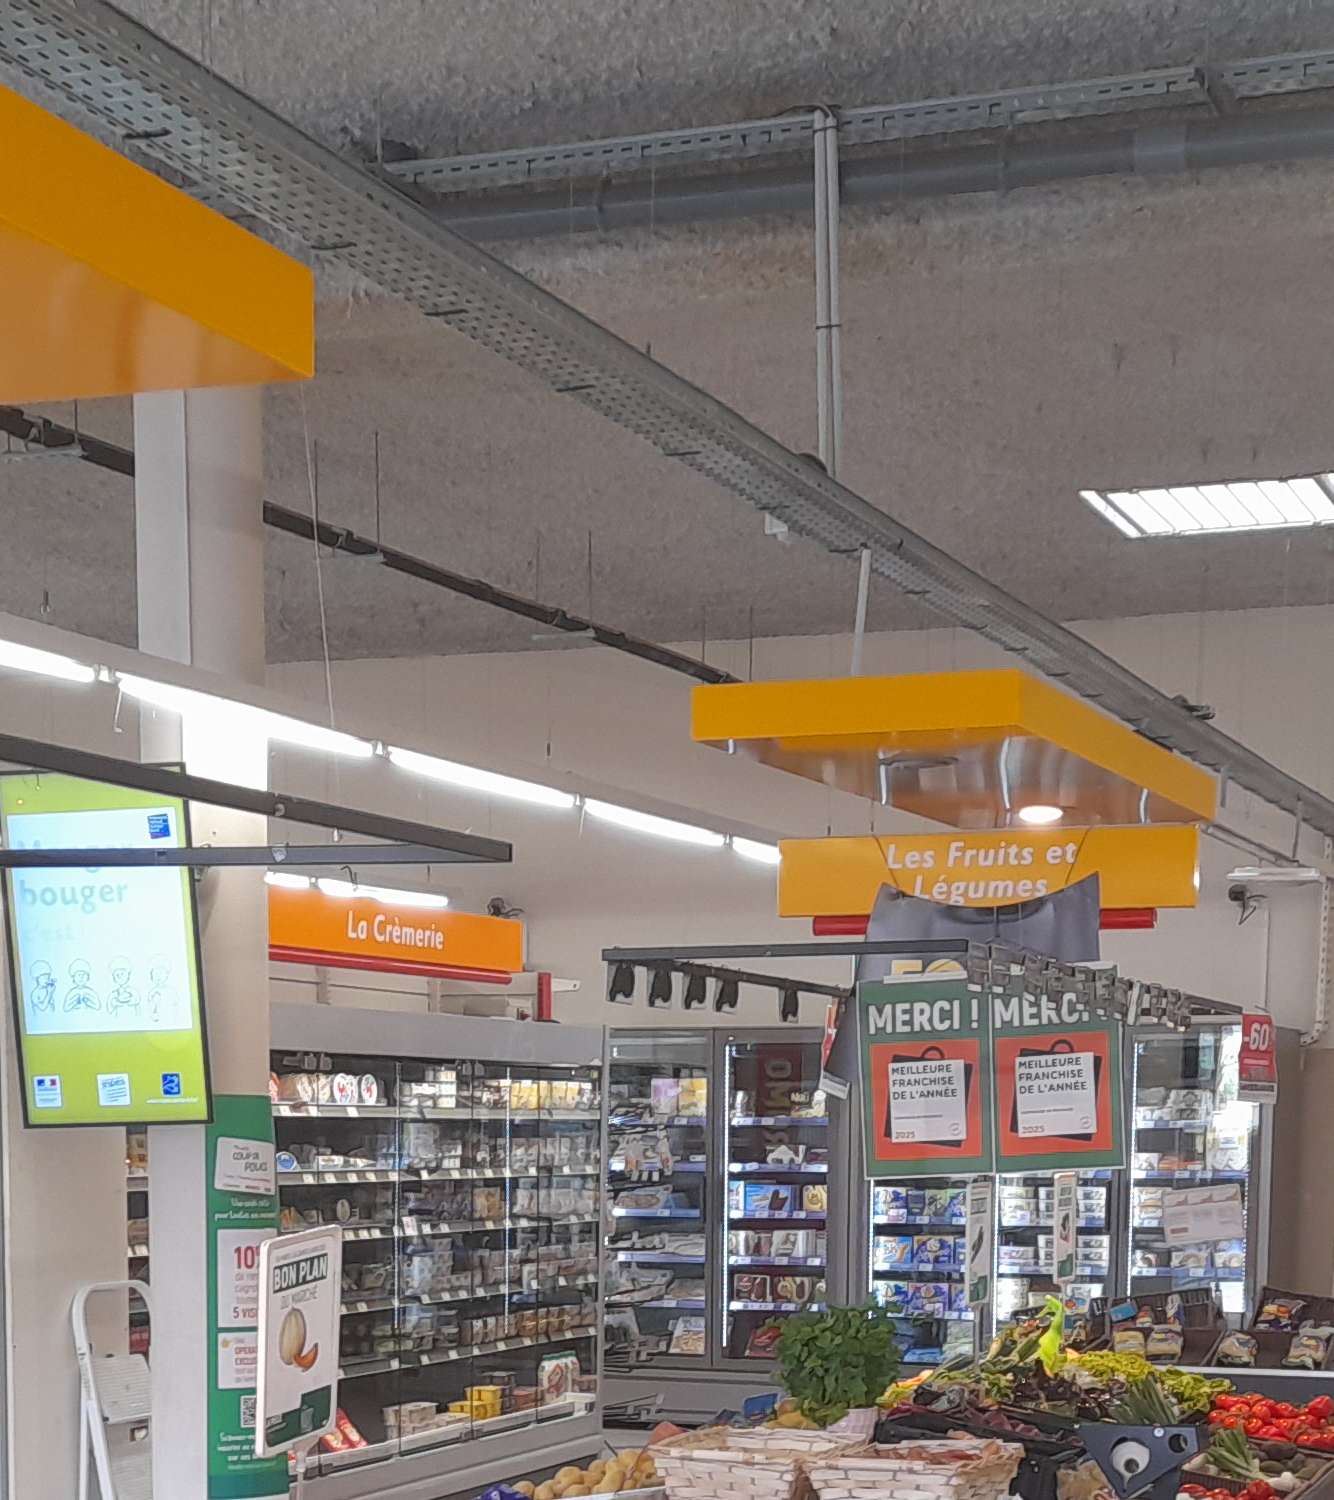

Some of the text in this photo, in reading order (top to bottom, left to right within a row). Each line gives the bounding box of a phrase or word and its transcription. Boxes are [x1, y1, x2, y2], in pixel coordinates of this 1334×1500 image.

[887, 840, 1078, 870] Les Fruits et
[19, 880, 128, 913] bouger
[913, 876, 1049, 905] Légumes
[346, 910, 445, 951] La Crèmerie
[868, 998, 979, 1035] MERCI !
[891, 1064, 953, 1076] MEILLEURE
[1018, 1057, 1082, 1070] MEILLEURE
[892, 1076, 955, 1088] FRANCHISE
[1018, 1069, 1084, 1081] FRANCHISE
[892, 1086, 958, 1100] DE L'ANNÉE
[1019, 1080, 1088, 1095] DE L'ANNÉE
[274, 1255, 328, 1290] BON PLAN
